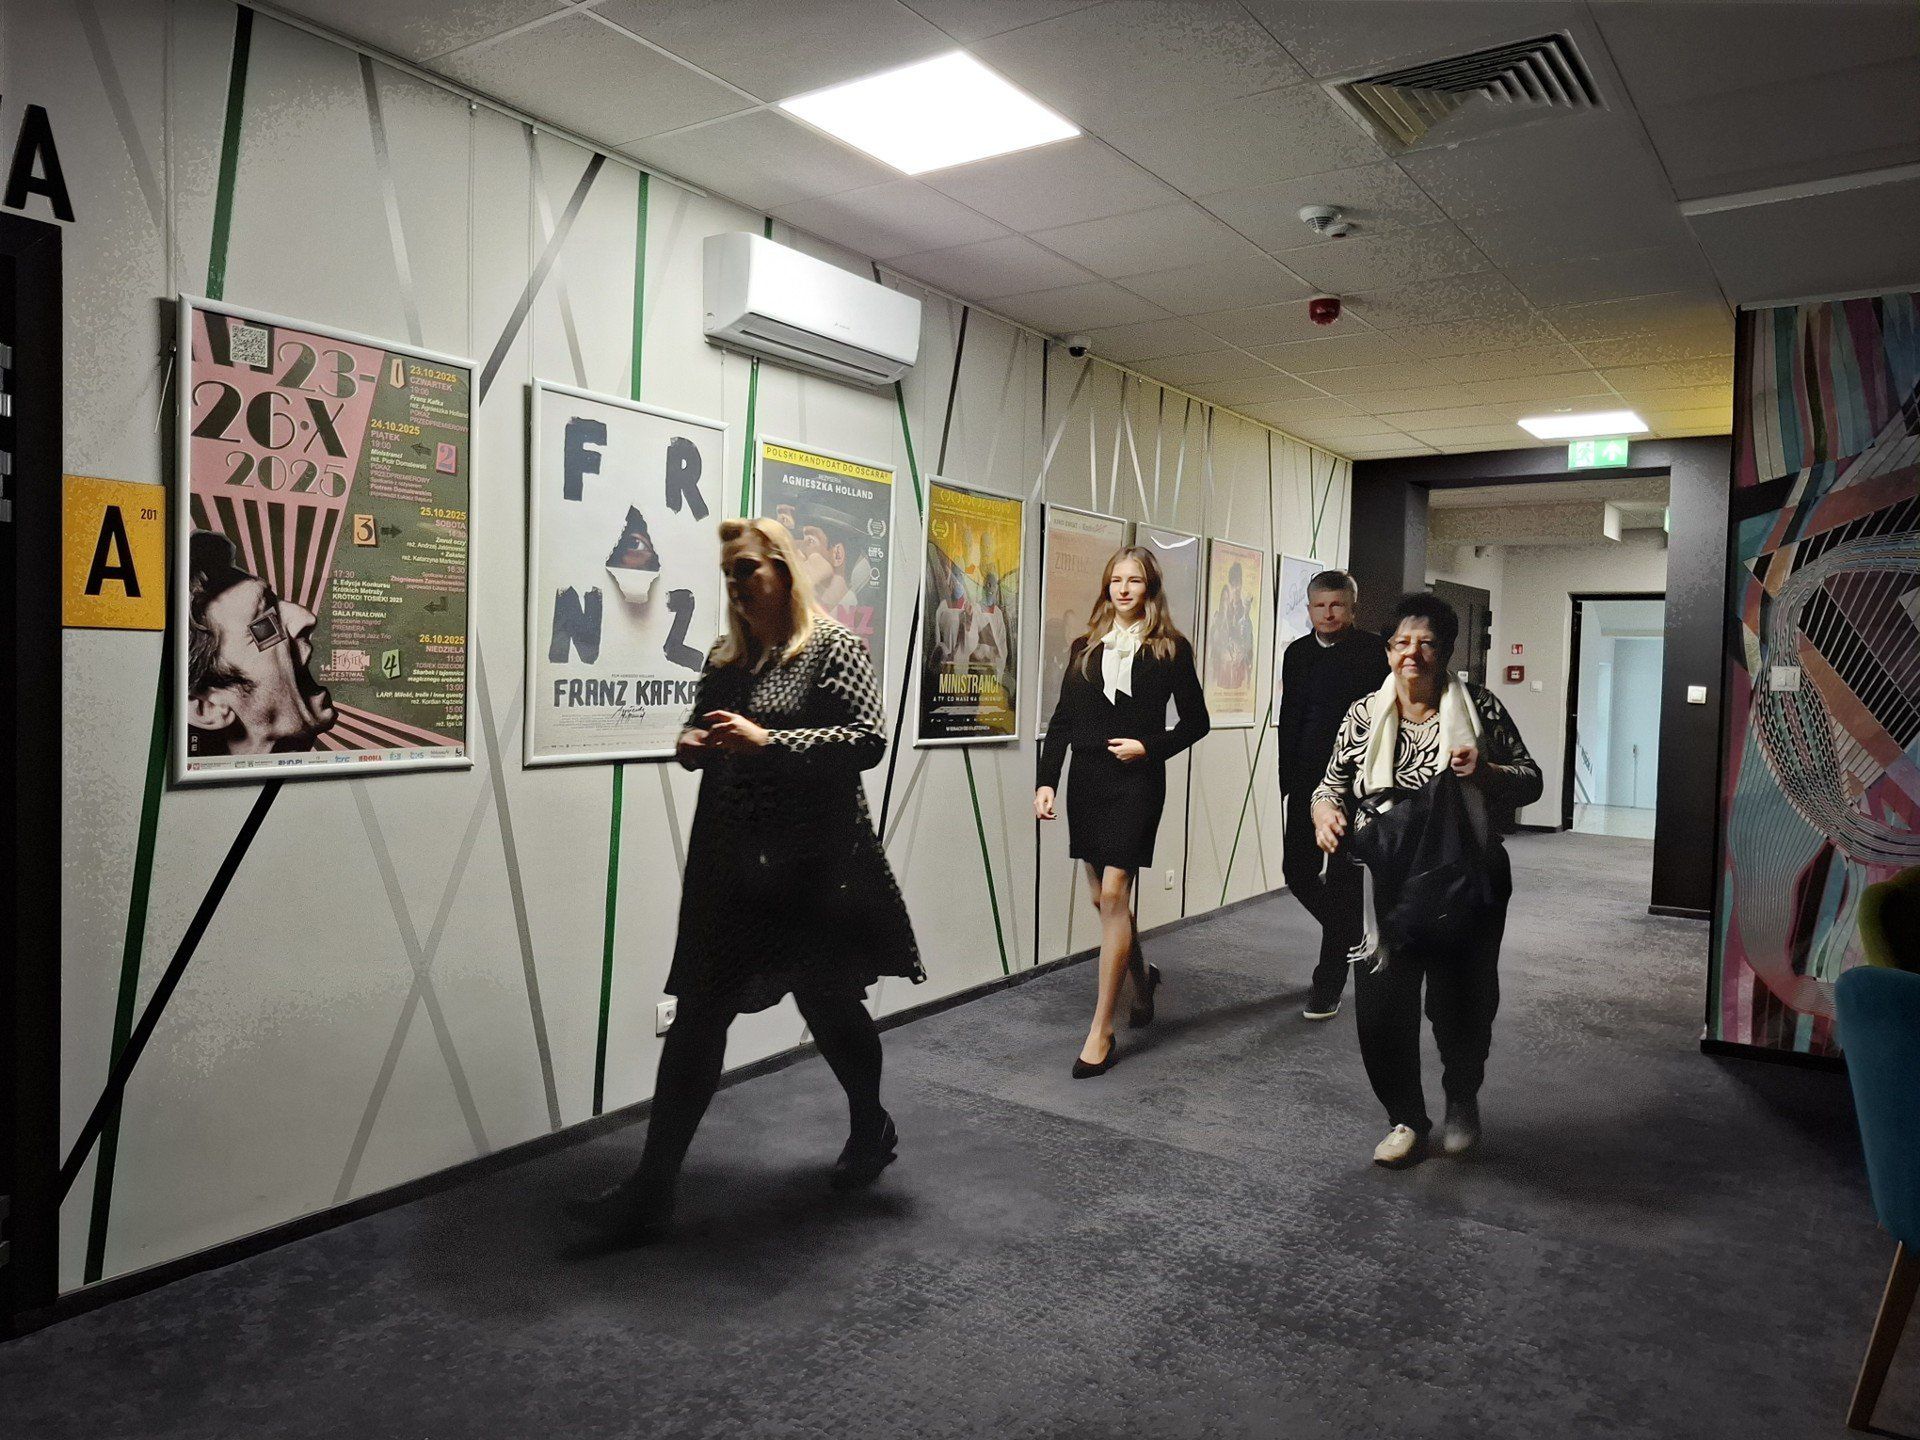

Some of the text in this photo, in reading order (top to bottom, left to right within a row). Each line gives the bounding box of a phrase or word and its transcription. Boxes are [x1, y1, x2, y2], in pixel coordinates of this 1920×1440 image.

[410, 365, 457, 383] 23.10.2025
[410, 377, 453, 393] CZWARTEK
[370, 418, 421, 436] 24.10.2025
[439, 444, 455, 471] 2
[766, 446, 797, 459] POLSKI
[799, 454, 840, 470] KANDYDAT
[842, 463, 854, 473] DO
[224, 450, 348, 498] 2025
[782, 474, 875, 500] AGNIESZKA HOLLAND
[141, 508, 157, 520] 201
[420, 506, 467, 521] 25.10.2025
[356, 517, 374, 542] 3
[435, 520, 466, 529] SOBOTA
[84, 505, 141, 597] A
[334, 570, 355, 579] 17:30
[340, 579, 361, 588] Edycja
[361, 581, 391, 589] Konkursu
[332, 601, 355, 610] 20:00
[419, 634, 465, 645] 26.10.2025
[425, 645, 465, 654] NIEDZIELA
[383, 653, 398, 678] 4
[553, 678, 702, 708] FRANZ KAFKA
